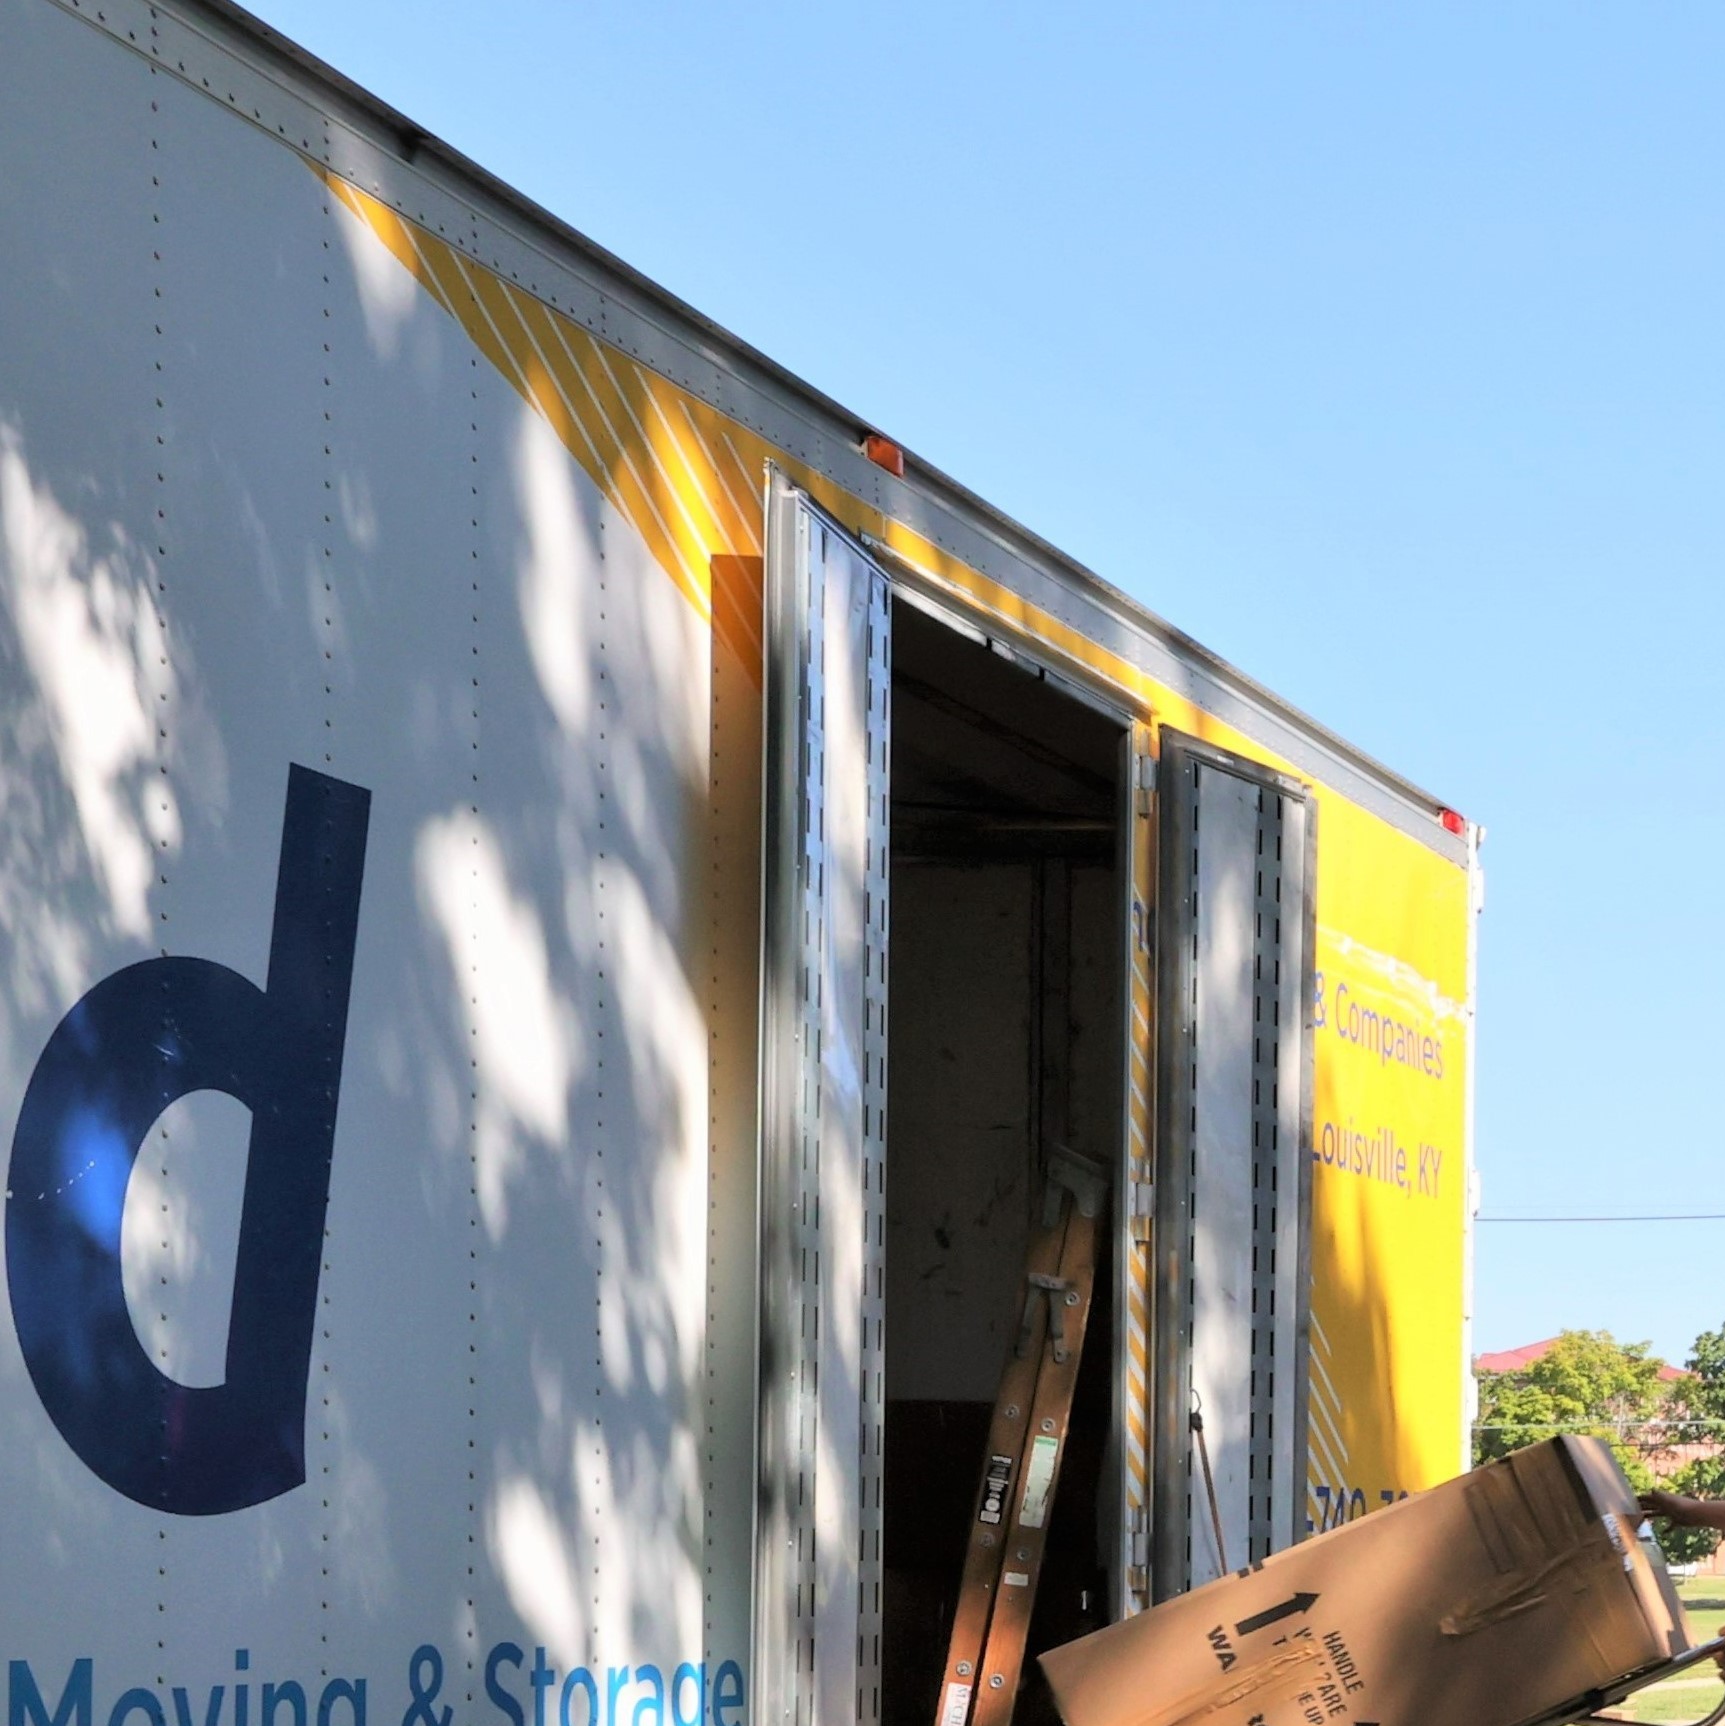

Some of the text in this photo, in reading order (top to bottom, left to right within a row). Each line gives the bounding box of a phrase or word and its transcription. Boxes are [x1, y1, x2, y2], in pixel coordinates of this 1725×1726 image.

[1336, 982, 1443, 1080] Companies
[1313, 1116, 1442, 1199] ouisville, KY
[1323, 1630, 1365, 1694] HANDLE
[1304, 1706, 1325, 1726] UP
